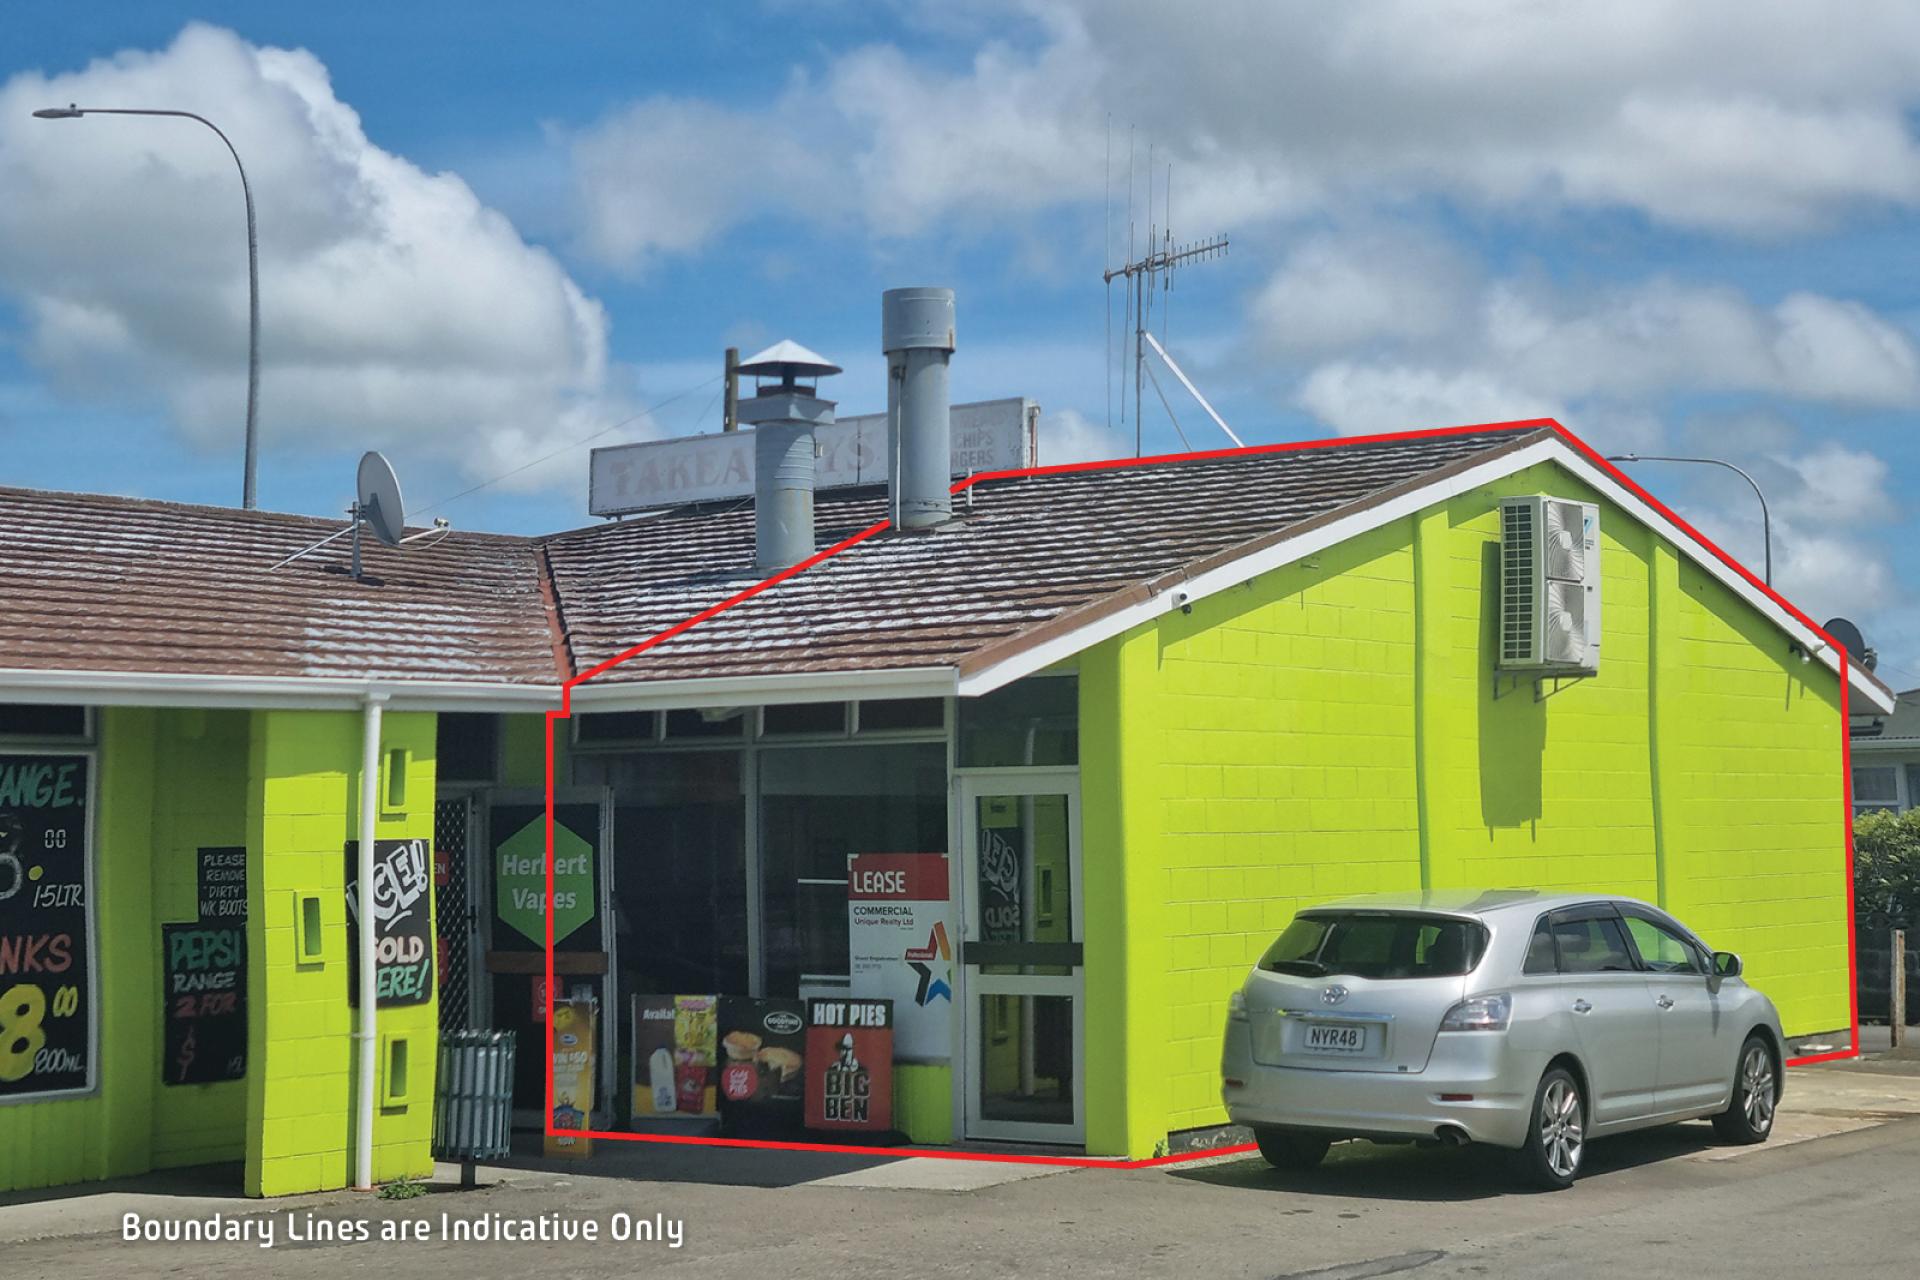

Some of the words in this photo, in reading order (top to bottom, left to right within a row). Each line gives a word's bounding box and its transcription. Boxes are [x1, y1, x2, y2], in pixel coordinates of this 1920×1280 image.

[605, 432, 878, 497] TAKEAYS
[951, 448, 994, 467] RGERS
[0, 763, 83, 809] ANGE.
[203, 853, 246, 867] PLEASE
[206, 868, 246, 882] REMOVE
[853, 871, 906, 893] LEASE
[218, 899, 248, 917] BOOTS
[853, 906, 913, 916] COMMERCIAL
[854, 917, 879, 927] Unique
[880, 917, 902, 927] Realty
[903, 918, 914, 926] Ltd
[0, 933, 72, 976] NKS
[169, 929, 241, 971] PEPSI
[173, 971, 237, 993] RANGE
[376, 958, 430, 1000] ERE!
[813, 1003, 845, 1026] HOT
[849, 1003, 886, 1027] PIES
[1310, 1025, 1357, 1047] NYR48
[825, 1070, 871, 1097] BIG
[824, 1096, 870, 1122] BEN
